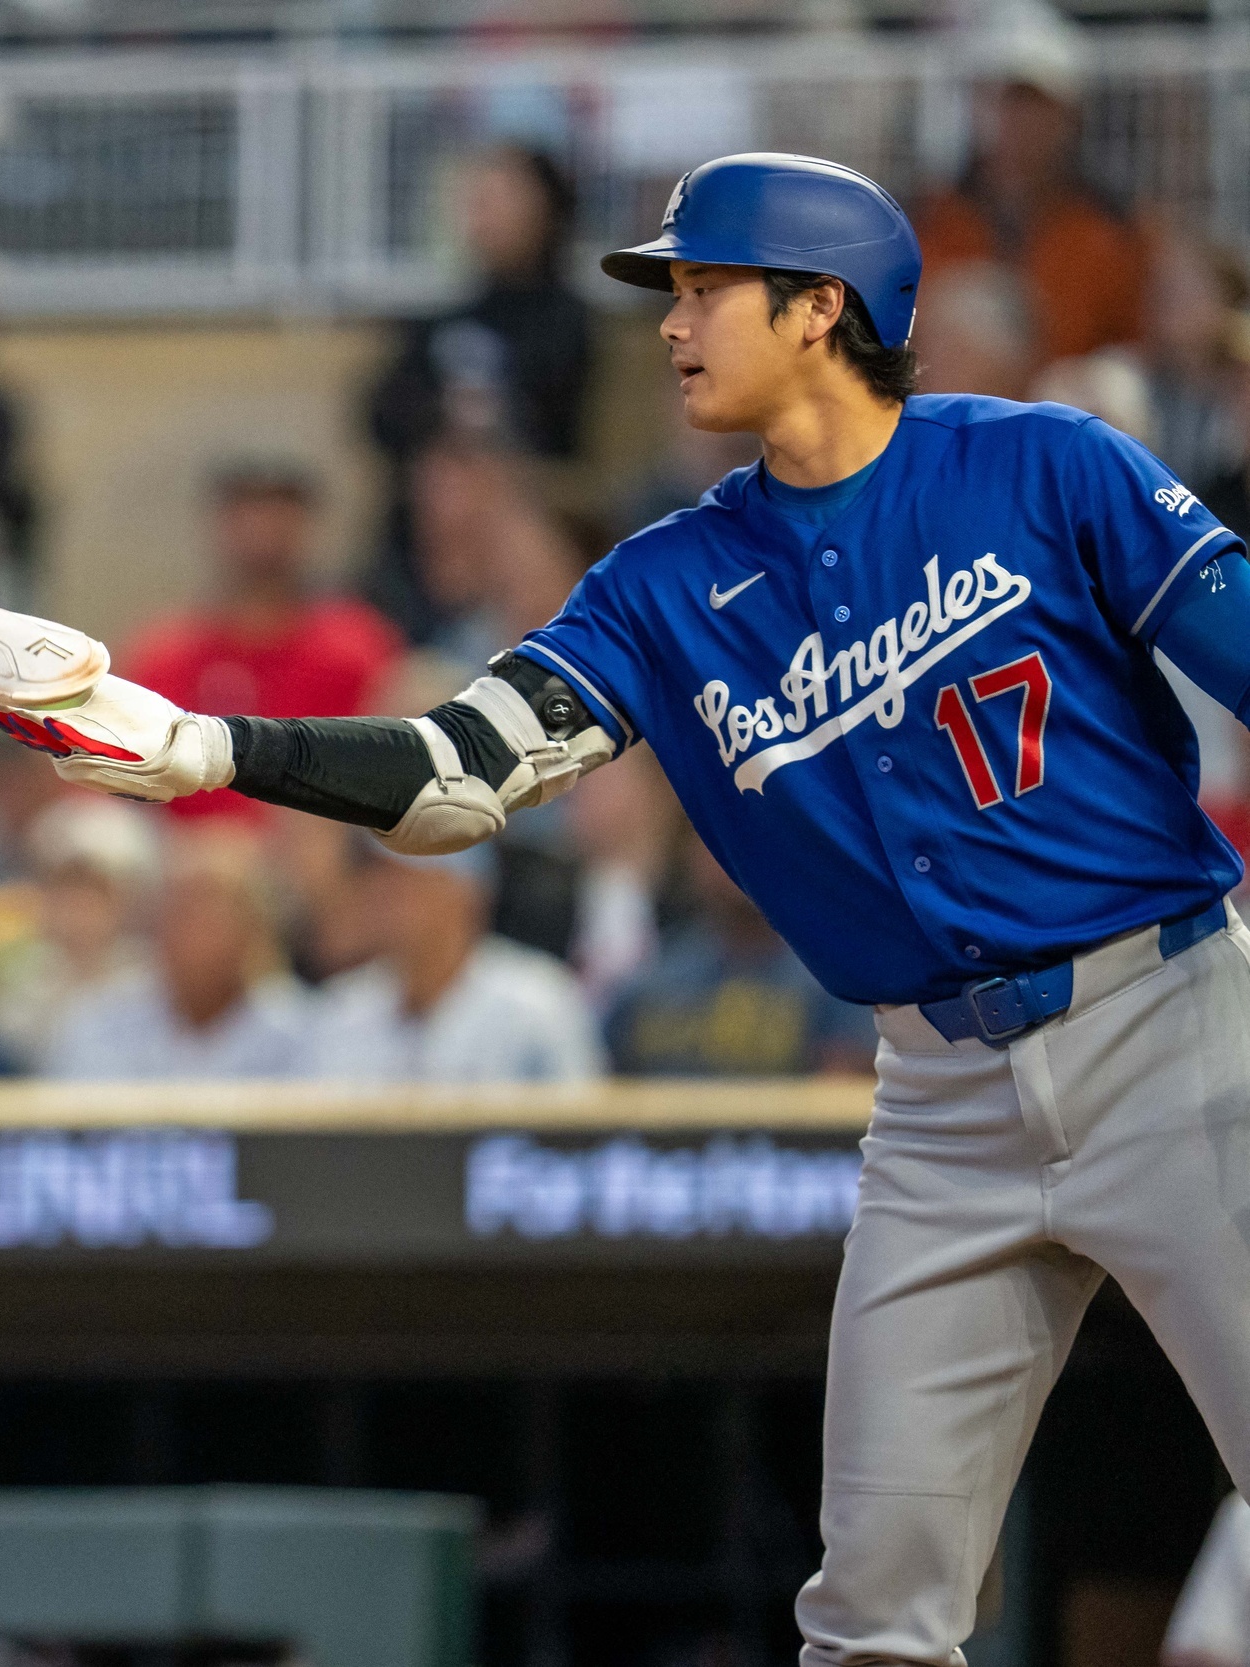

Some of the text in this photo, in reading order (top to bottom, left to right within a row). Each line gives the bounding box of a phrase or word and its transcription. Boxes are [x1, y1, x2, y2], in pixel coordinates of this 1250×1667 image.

[693, 552, 1031, 767] Los Angeles
[934, 651, 1052, 811] 17
